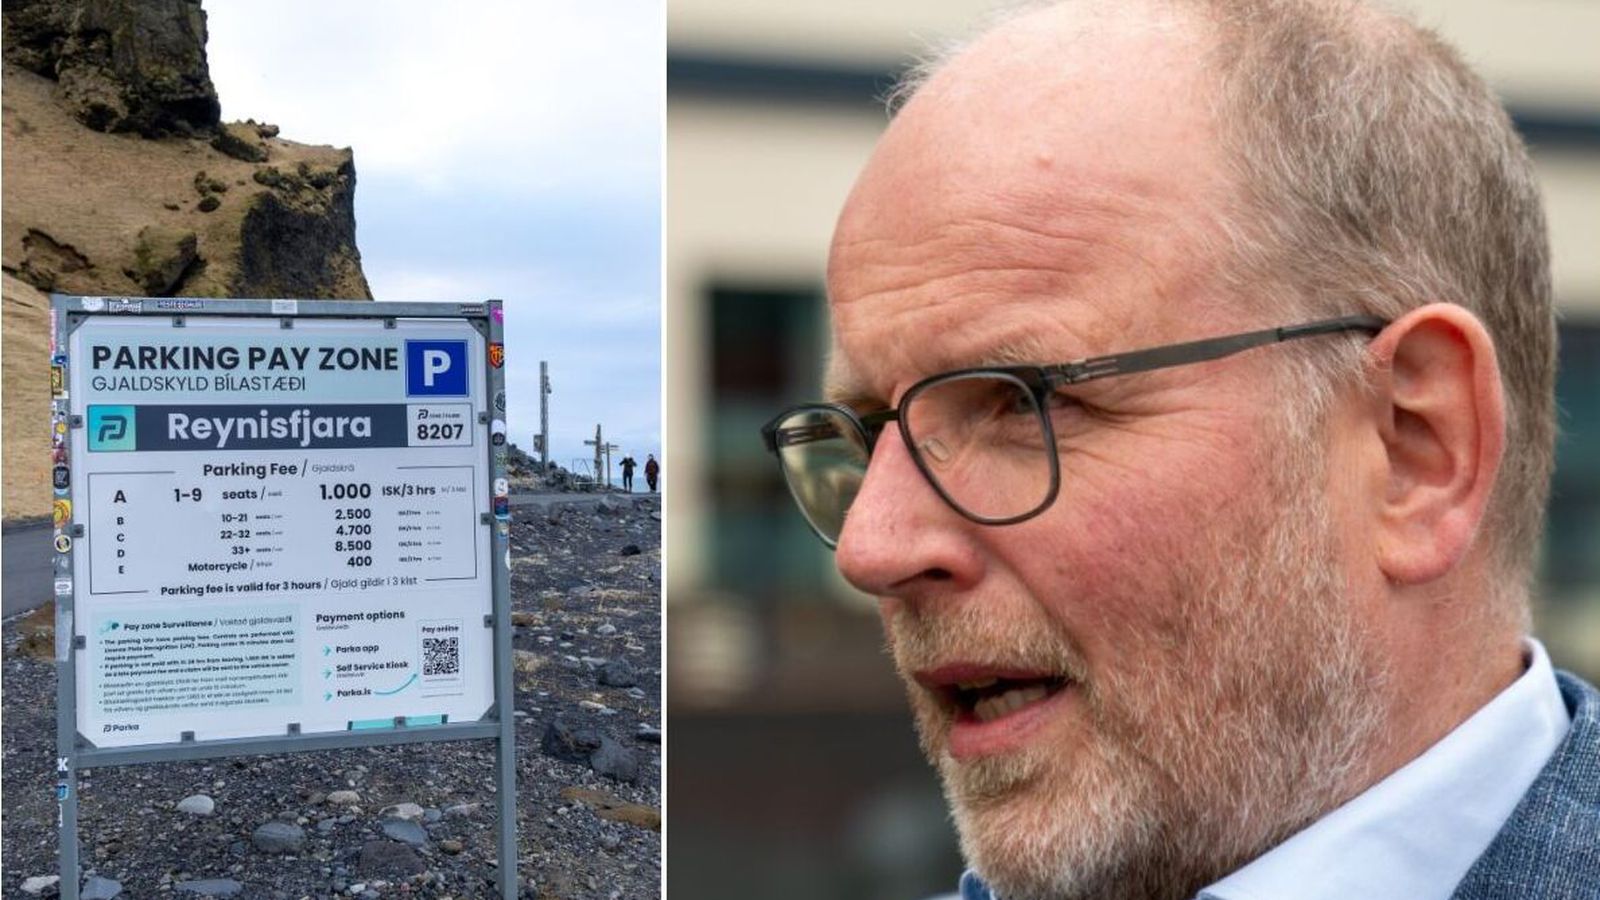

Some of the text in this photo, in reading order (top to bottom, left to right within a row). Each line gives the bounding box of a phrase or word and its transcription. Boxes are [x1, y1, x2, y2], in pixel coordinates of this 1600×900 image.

[92, 345, 398, 371] PARKING PAY ZONE
[424, 350, 452, 387] P
[92, 373, 306, 392] GJALDSKYLD BÍLASTÆÐI
[168, 409, 371, 448] Reynisfjara
[417, 424, 464, 440] 8207
[203, 462, 267, 480] Parking
[270, 463, 298, 476] Fee
[113, 489, 127, 503] A
[174, 488, 203, 503] 1-9
[222, 489, 258, 500] seats
[319, 483, 371, 500] 1.000
[382, 484, 413, 498] ISK/3
[416, 484, 436, 495] hrs
[222, 513, 248, 523] 10-21
[335, 508, 371, 520] 2.500
[117, 516, 124, 525] B
[220, 530, 250, 540] 22-32
[336, 524, 371, 536] 4.700
[117, 533, 125, 542] C
[232, 546, 251, 555] 33+
[335, 540, 372, 551] 8.500
[117, 549, 125, 558] D
[188, 561, 248, 573] Motorcycle
[347, 556, 372, 567] 400
[118, 565, 125, 574] E
[161, 585, 204, 597] Parking
[206, 584, 223, 593] fee
[225, 584, 234, 593] is
[237, 582, 263, 592] valid
[265, 582, 280, 591] for
[282, 581, 289, 590] 3
[291, 580, 322, 590] hours
[331, 578, 358, 591] Gjald
[393, 577, 399, 586] 3
[401, 575, 418, 586] klst
[316, 610, 406, 624] Payment options
[124, 623, 139, 632] Pay
[141, 621, 161, 630] zone
[163, 620, 213, 629] Surveillance
[422, 626, 435, 634] Pay
[336, 645, 380, 654] Parka app
[336, 661, 408, 672] Self Service Kiosk
[337, 688, 371, 697] Parka.is
[112, 723, 140, 732] Parka
